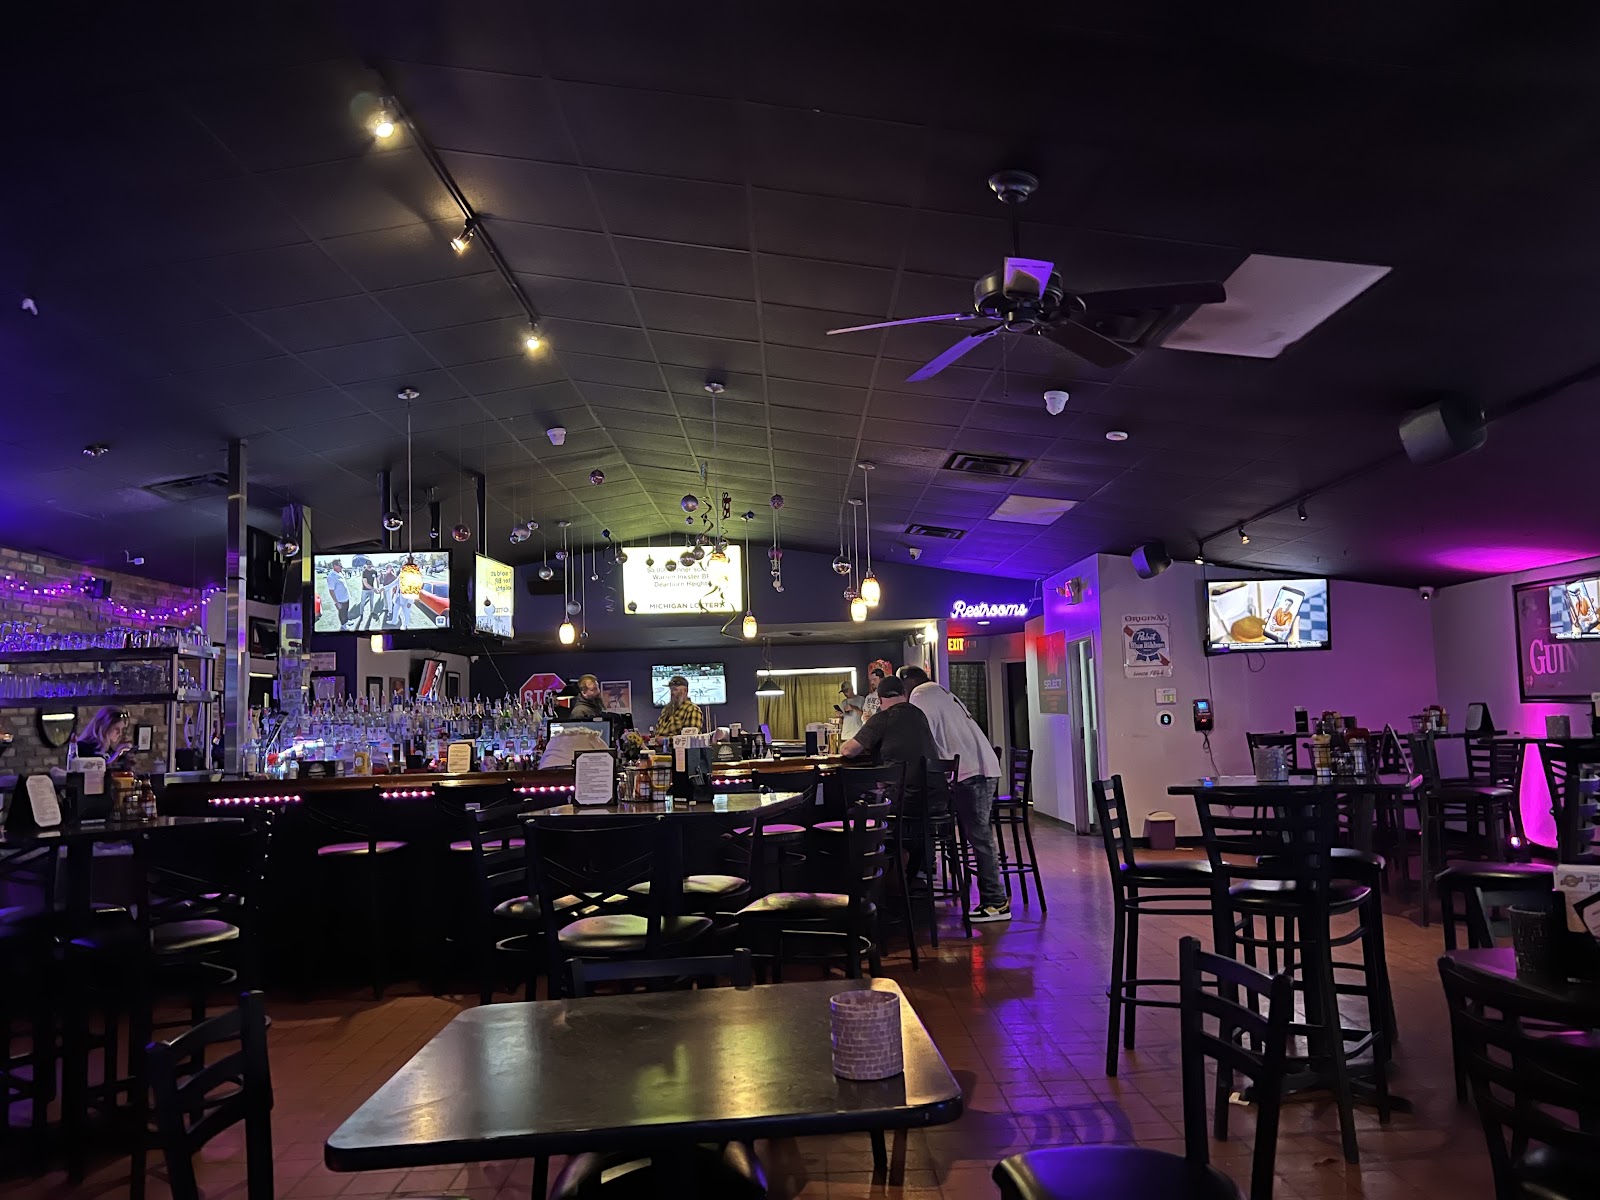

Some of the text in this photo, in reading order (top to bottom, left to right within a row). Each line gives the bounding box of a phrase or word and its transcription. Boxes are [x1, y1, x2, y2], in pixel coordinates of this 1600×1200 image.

[950, 599, 1027, 618] Restrooms
[1124, 614, 1168, 623] ORIGINAL
[947, 637, 964, 651] EXIT
